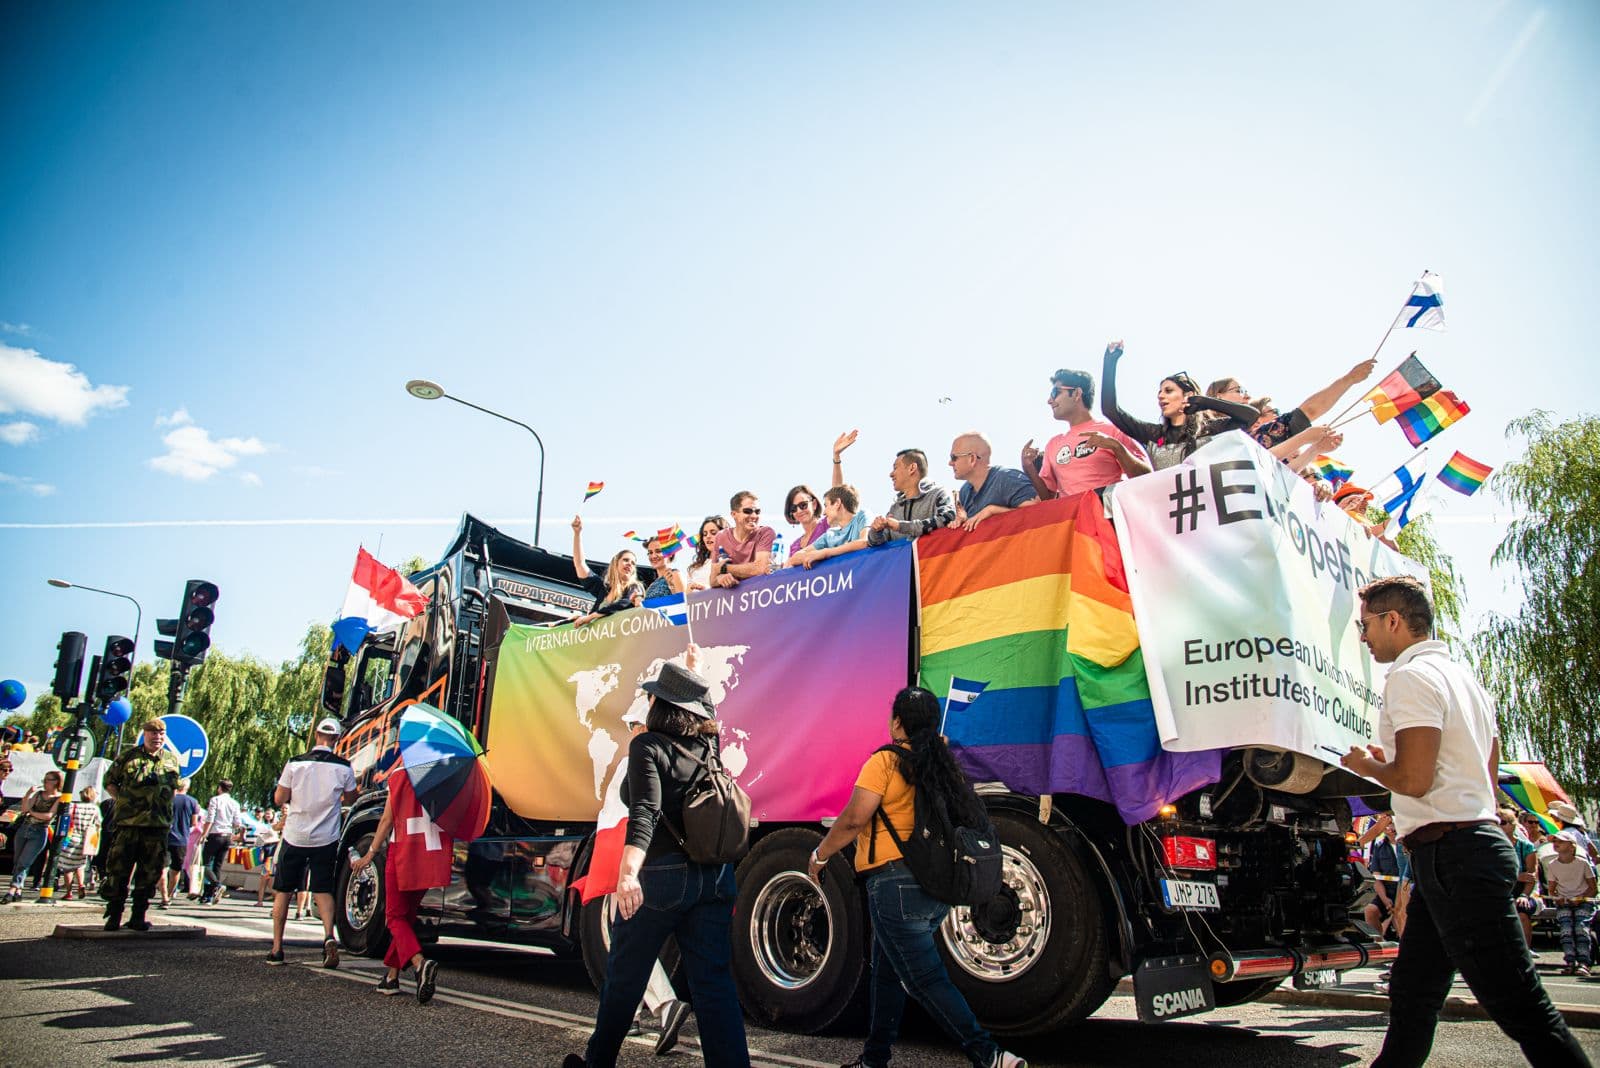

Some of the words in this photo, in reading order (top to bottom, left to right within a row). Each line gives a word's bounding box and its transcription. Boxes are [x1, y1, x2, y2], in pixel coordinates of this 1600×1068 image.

[498, 579, 538, 598] WILDA
[540, 589, 593, 613] TRANSPO
[526, 622, 617, 653] INTERNATIONAL
[620, 600, 712, 637] COMMITY
[716, 595, 734, 617] IN
[740, 569, 853, 612] STOCKHOLM
[1184, 636, 1311, 667] European
[1313, 644, 1347, 689] Union
[1344, 670, 1384, 711] Nationa
[1185, 673, 1311, 707] Institutes
[1312, 686, 1330, 718] for
[1332, 697, 1372, 740] Culture
[1195, 885, 1216, 905] 278
[1304, 969, 1337, 986] SCANIA
[1153, 987, 1206, 1017] SCANIA
